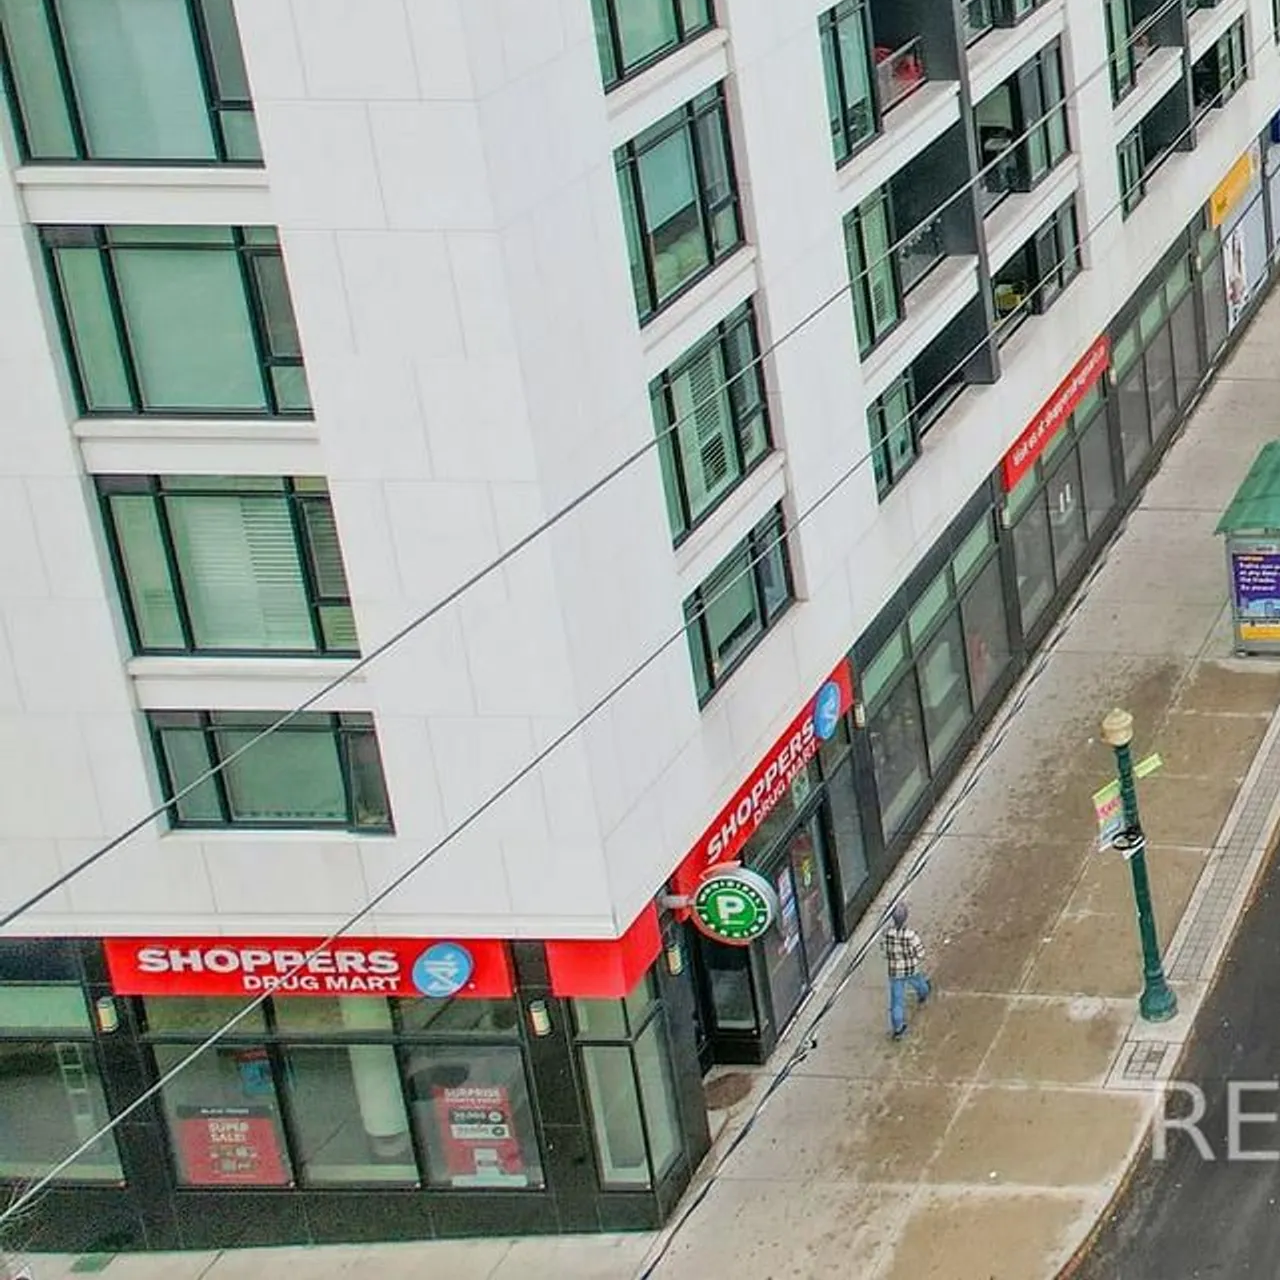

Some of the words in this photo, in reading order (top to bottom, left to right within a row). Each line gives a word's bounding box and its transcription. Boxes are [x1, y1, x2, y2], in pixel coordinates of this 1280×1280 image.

[706, 715, 815, 864] SHOPPERS
[753, 784, 786, 828] DRUG
[716, 895, 746, 921] P
[137, 948, 401, 973] SHOPPERS
[243, 975, 319, 990] DRUG
[325, 975, 401, 991] MART
